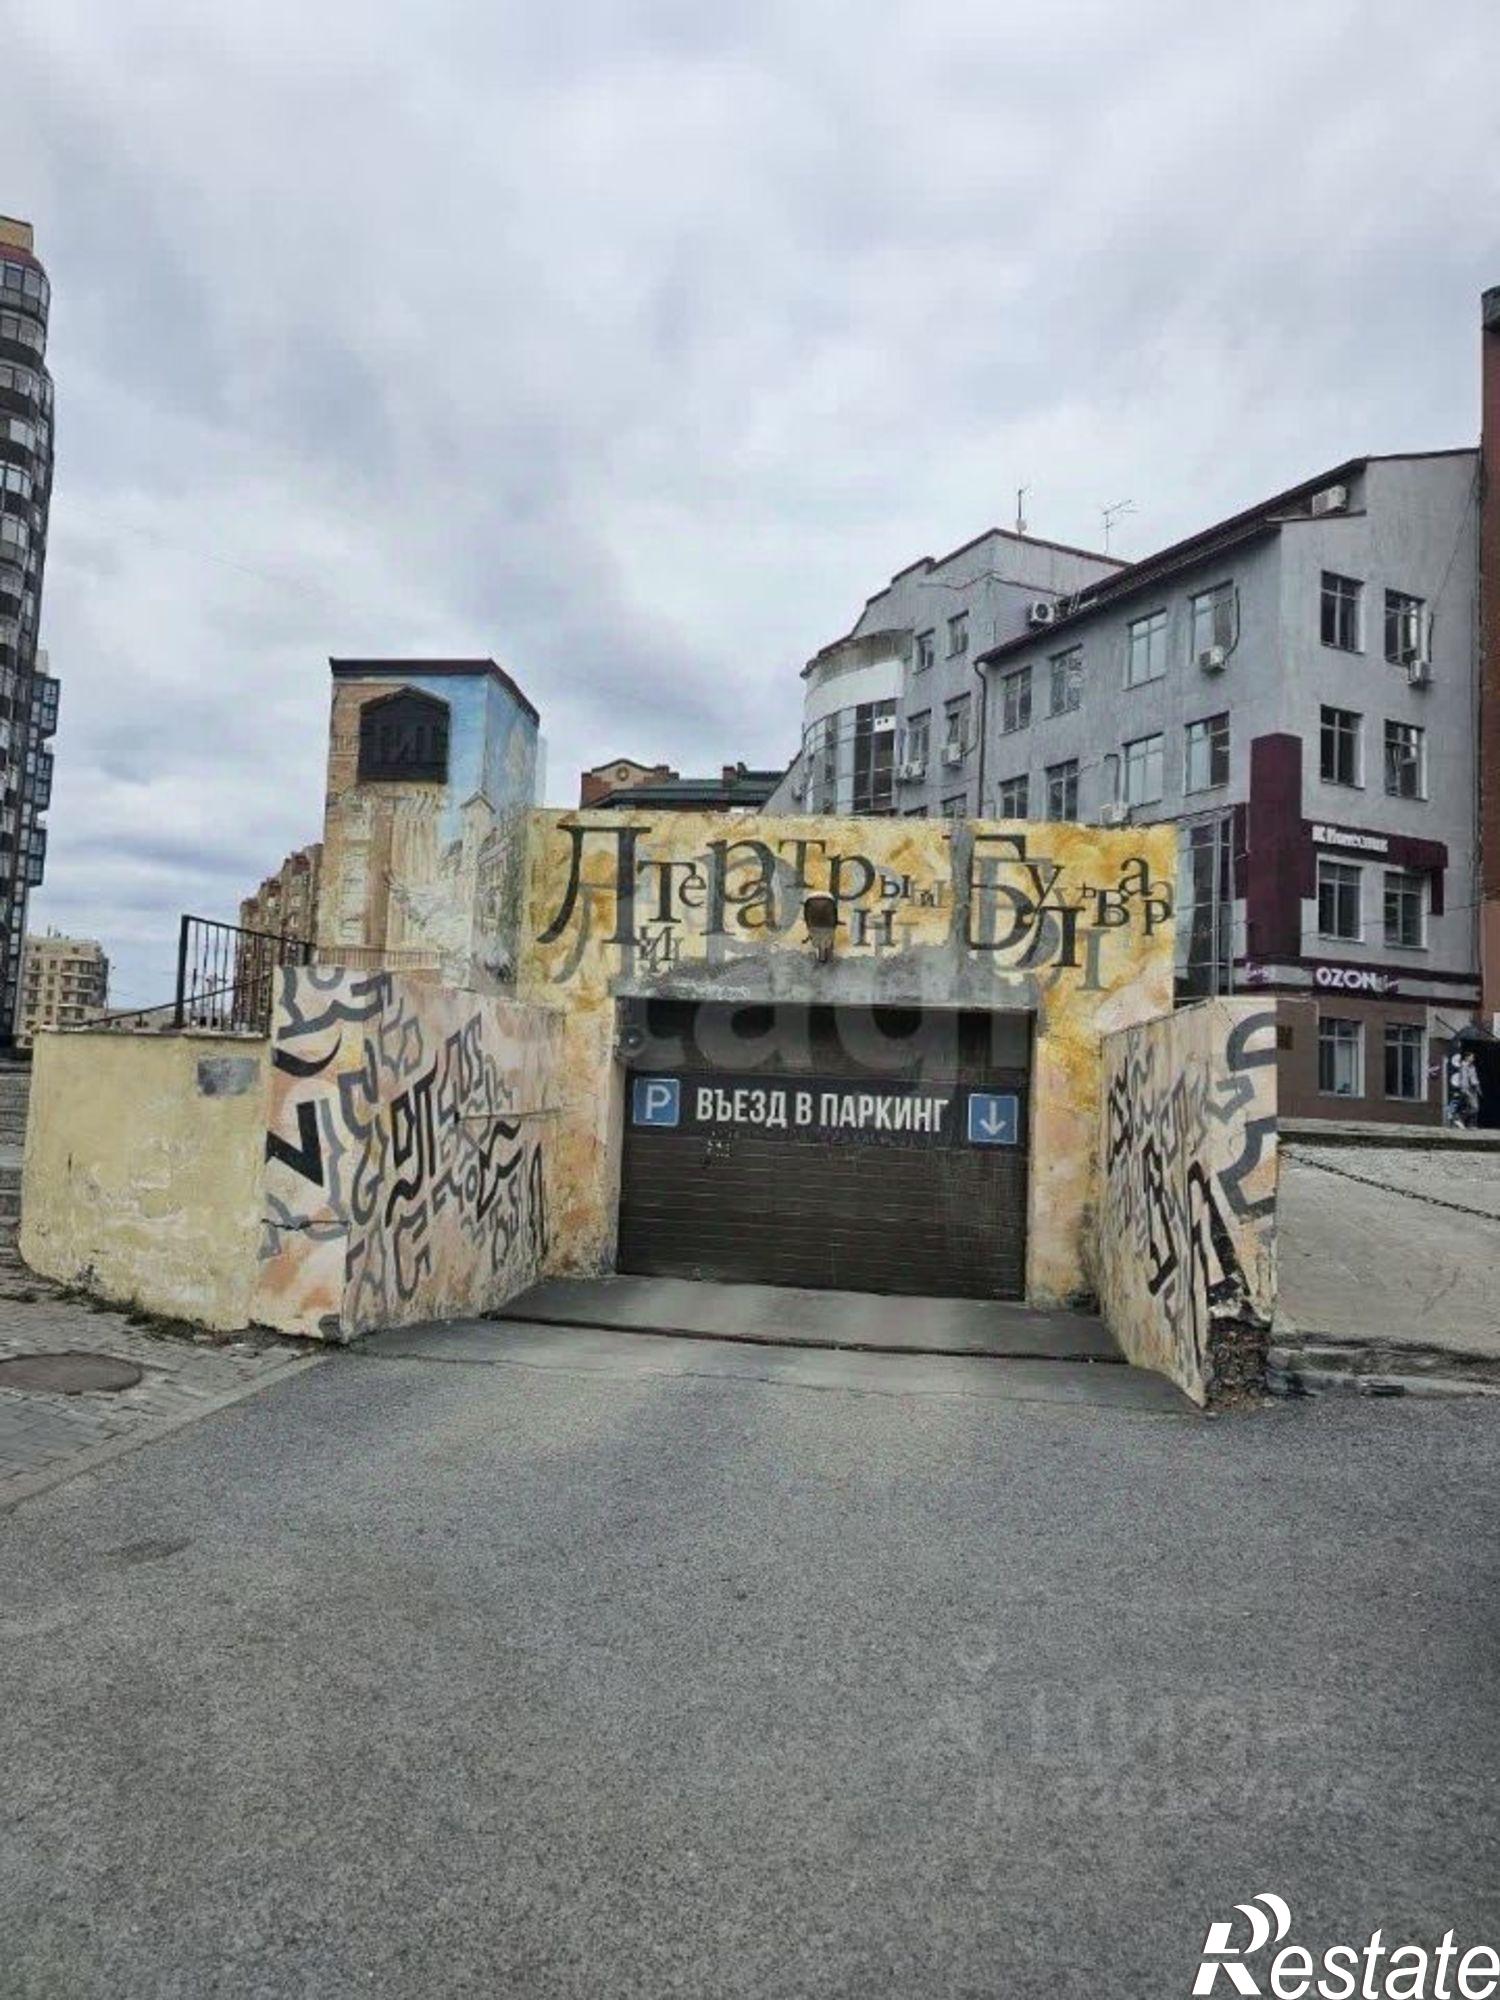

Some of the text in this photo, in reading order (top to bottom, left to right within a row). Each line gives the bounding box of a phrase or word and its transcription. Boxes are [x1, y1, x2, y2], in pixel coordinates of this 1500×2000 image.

[1316, 966, 1376, 990] OZON
[696, 1086, 949, 1132] ВЪЕЗД В ПАРКИНГ
